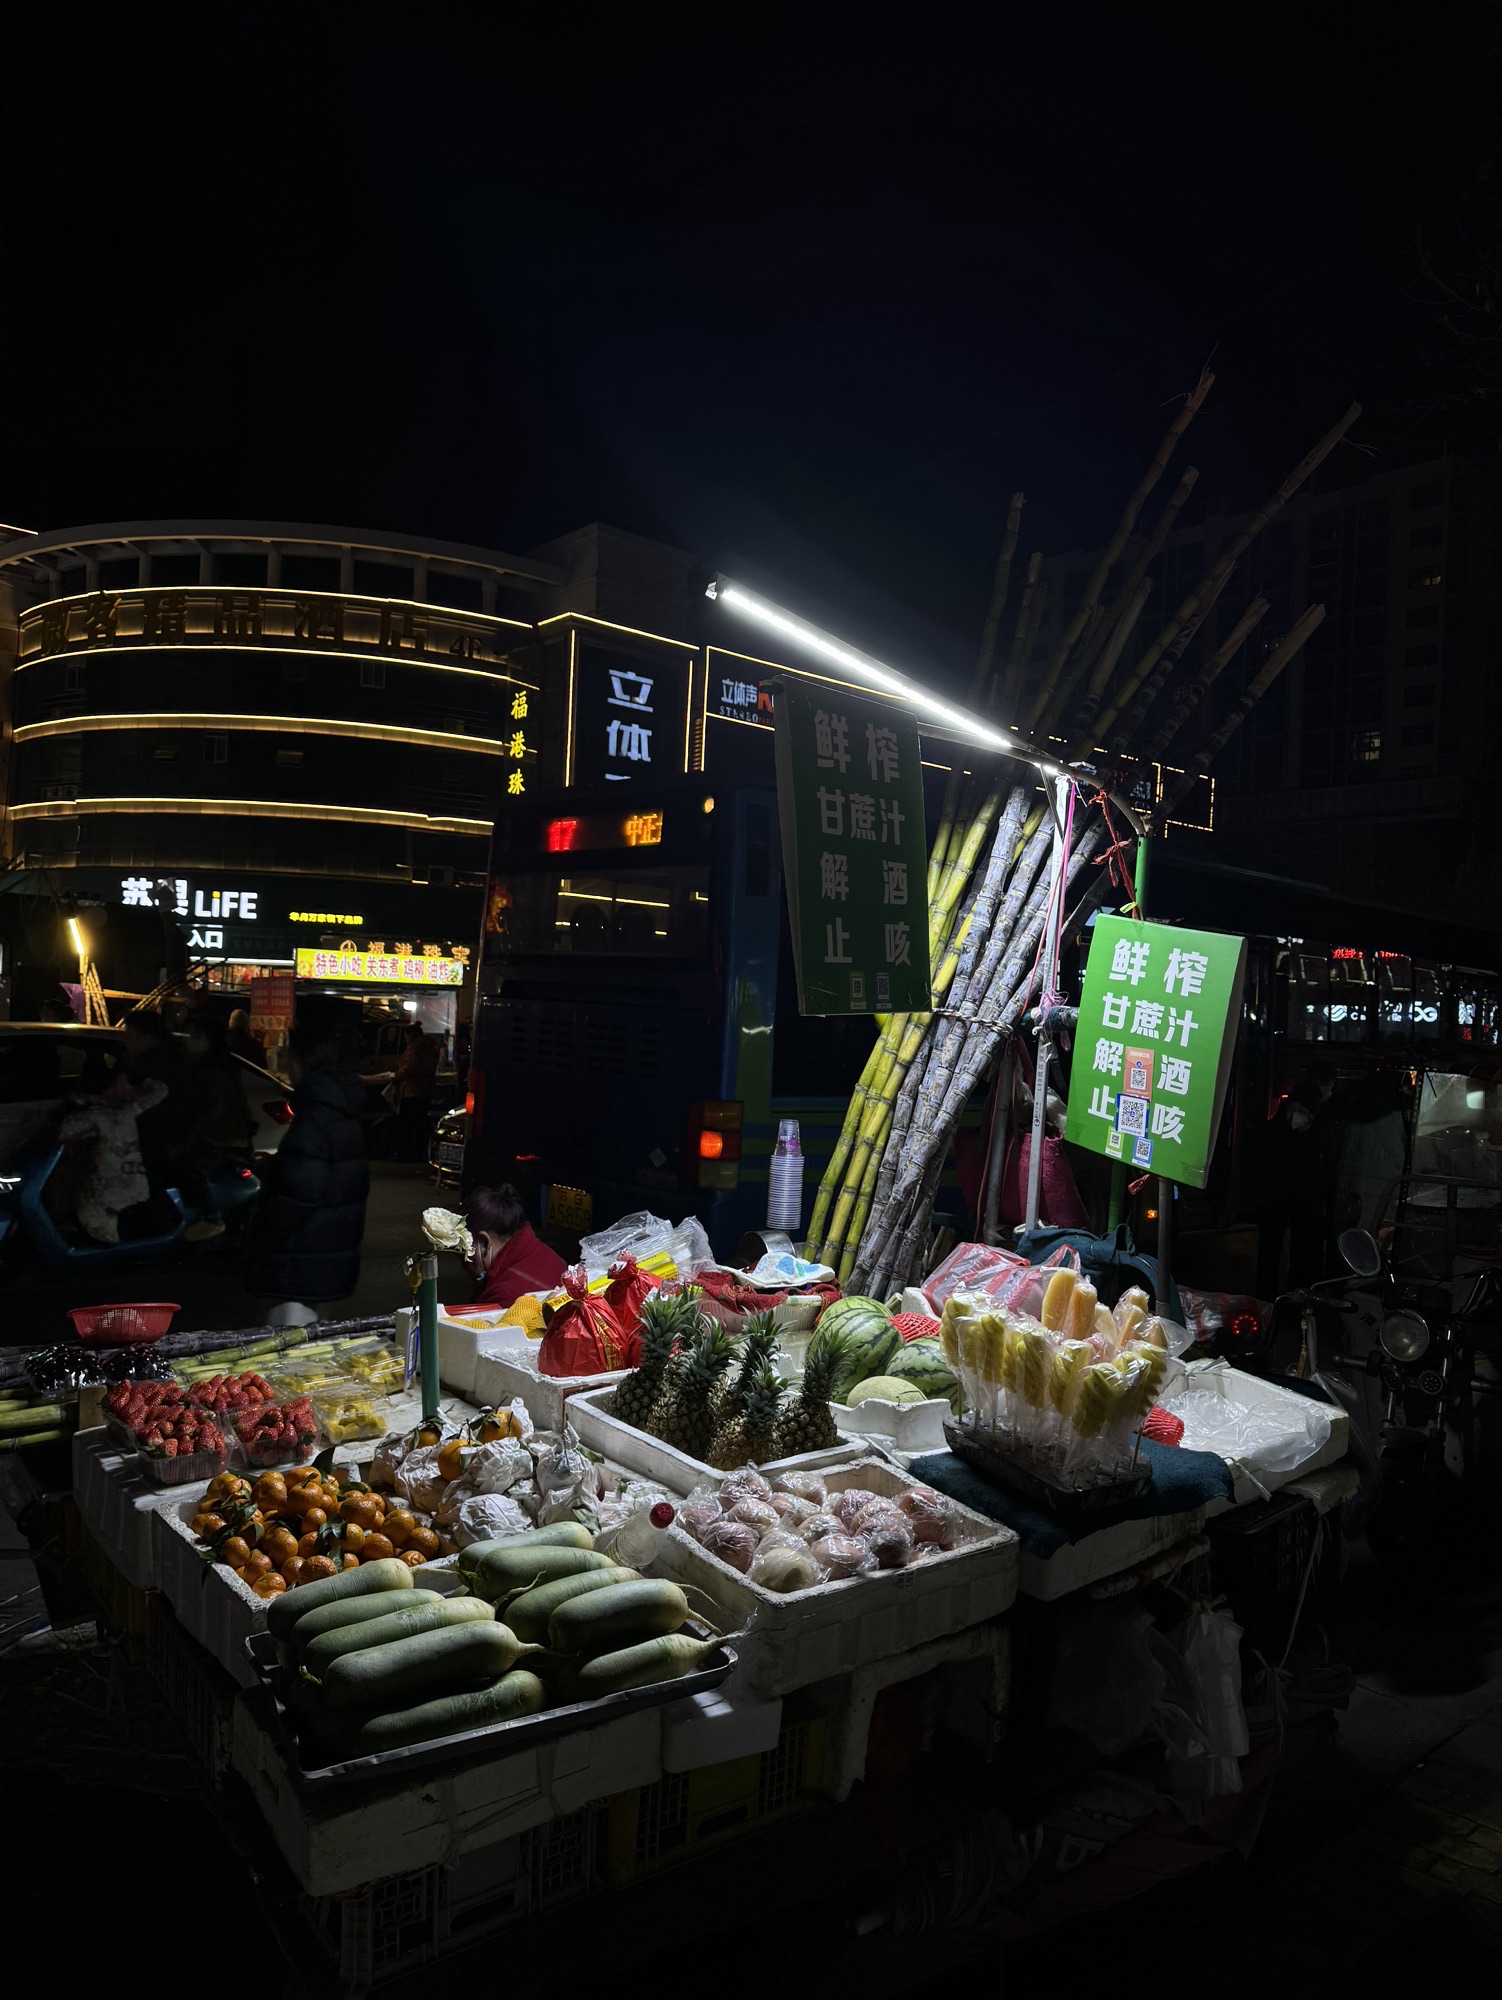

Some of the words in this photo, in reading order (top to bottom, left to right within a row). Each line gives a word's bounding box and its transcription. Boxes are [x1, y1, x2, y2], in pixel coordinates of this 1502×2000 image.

[507, 690, 530, 795] 福港珠
[606, 669, 653, 781] 立体
[625, 813, 662, 845] 中正
[817, 786, 905, 846] 甘蔗汁
[187, 929, 223, 949] 入口
[316, 953, 362, 978] 特色小吃
[367, 956, 399, 979] 关东煮
[403, 959, 425, 980] 鸡柳
[428, 961, 449, 982] 油炸
[1109, 938, 1209, 997] 鲜榨
[1101, 992, 1199, 1048] 甘蔗汁
